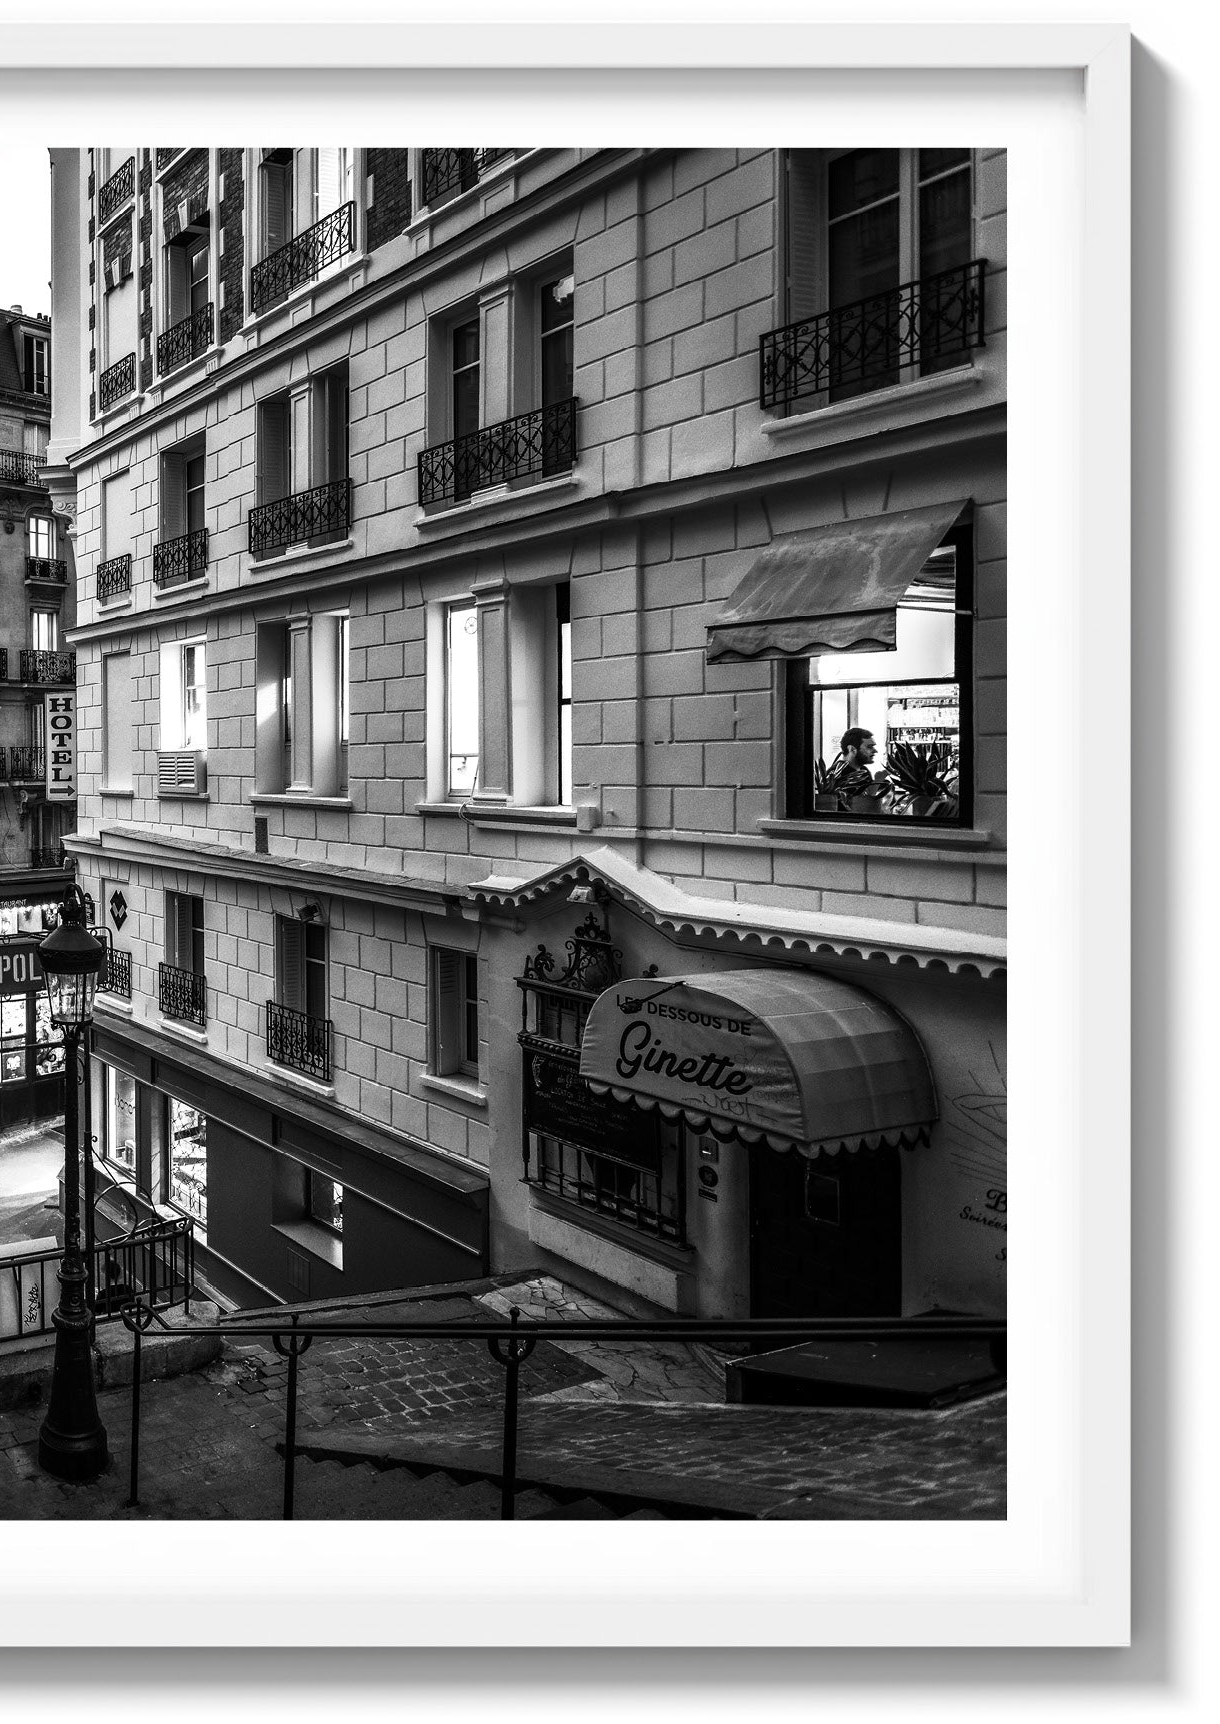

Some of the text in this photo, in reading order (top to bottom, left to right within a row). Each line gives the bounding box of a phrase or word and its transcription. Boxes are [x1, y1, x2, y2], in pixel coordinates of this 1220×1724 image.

[49, 697, 73, 782] HOTEL
[647, 1002, 722, 1030] DESSOUS
[727, 1018, 752, 1037] DE
[616, 1020, 753, 1095] Ginette
